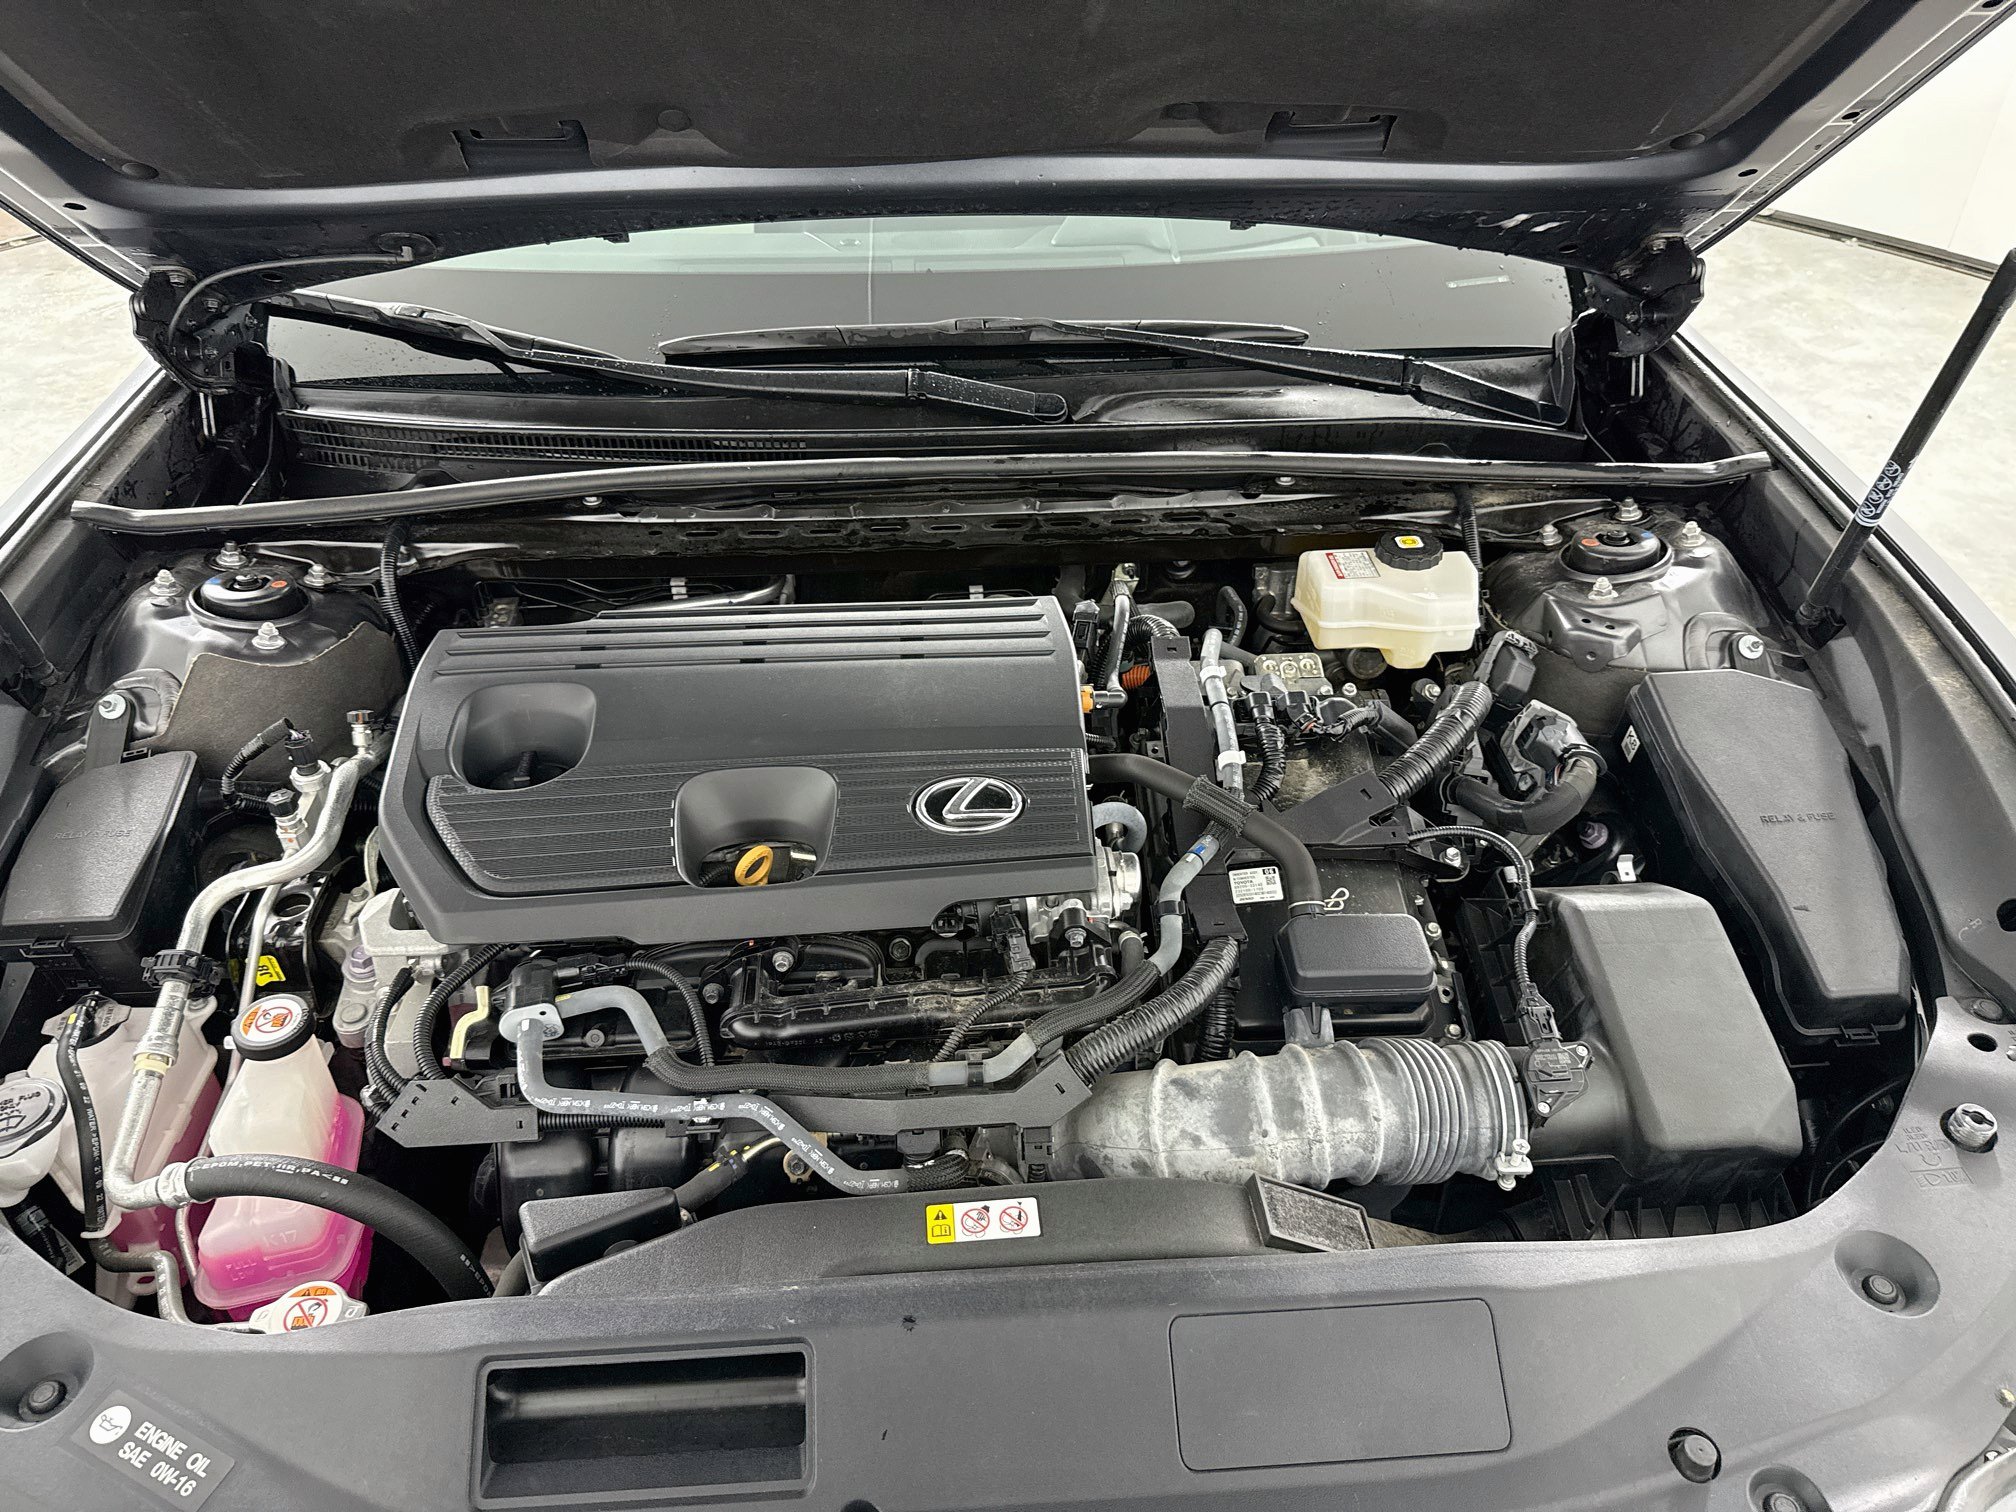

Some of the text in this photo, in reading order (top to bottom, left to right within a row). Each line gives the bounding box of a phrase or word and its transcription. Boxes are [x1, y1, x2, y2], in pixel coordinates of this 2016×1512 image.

[1760, 814, 1795, 824] RELAY
[1806, 812, 1836, 821] FUSE
[86, 1107, 98, 1132] WATER
[117, 1441, 197, 1497] SAE 0W-16
[133, 1421, 212, 1478] ENGINE OIL
